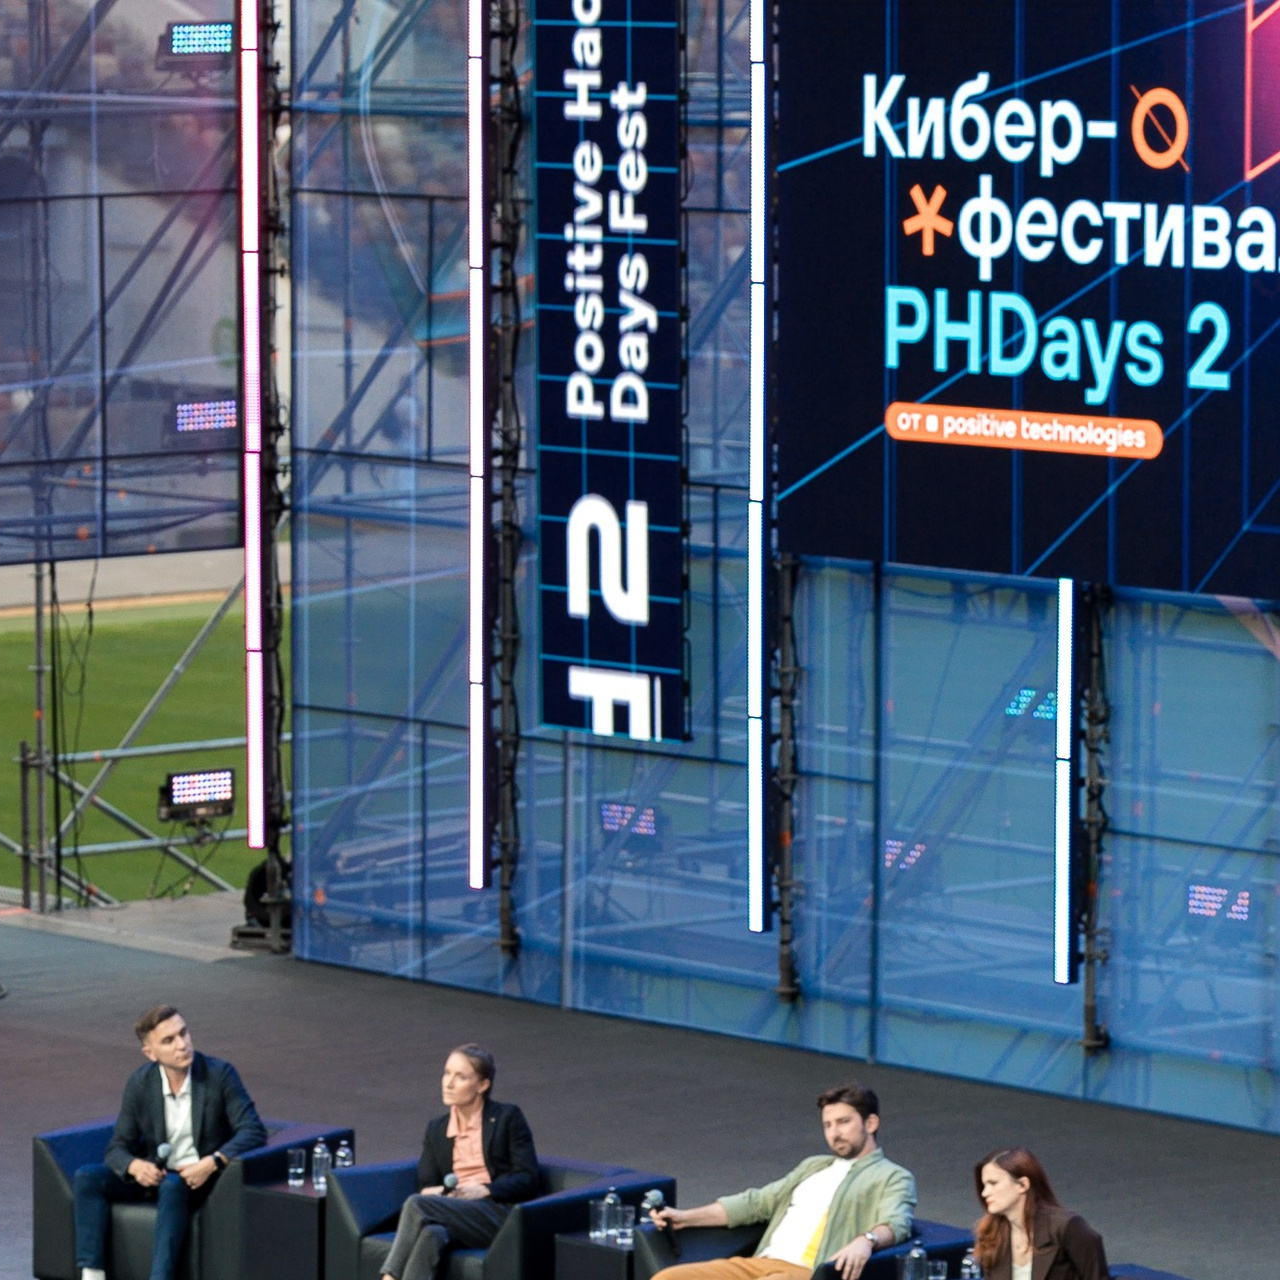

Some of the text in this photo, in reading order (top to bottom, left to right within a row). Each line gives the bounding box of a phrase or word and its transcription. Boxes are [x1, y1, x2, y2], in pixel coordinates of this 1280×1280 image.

[863, 72, 1118, 178] Кибер-
[564, 140, 605, 420] Positive
[609, 82, 658, 424] Days Fest
[958, 175, 1280, 282] фестива
[885, 285, 1231, 404] PHDays 2
[943, 414, 1147, 453] positive technologies
[567, 493, 649, 625] 2
